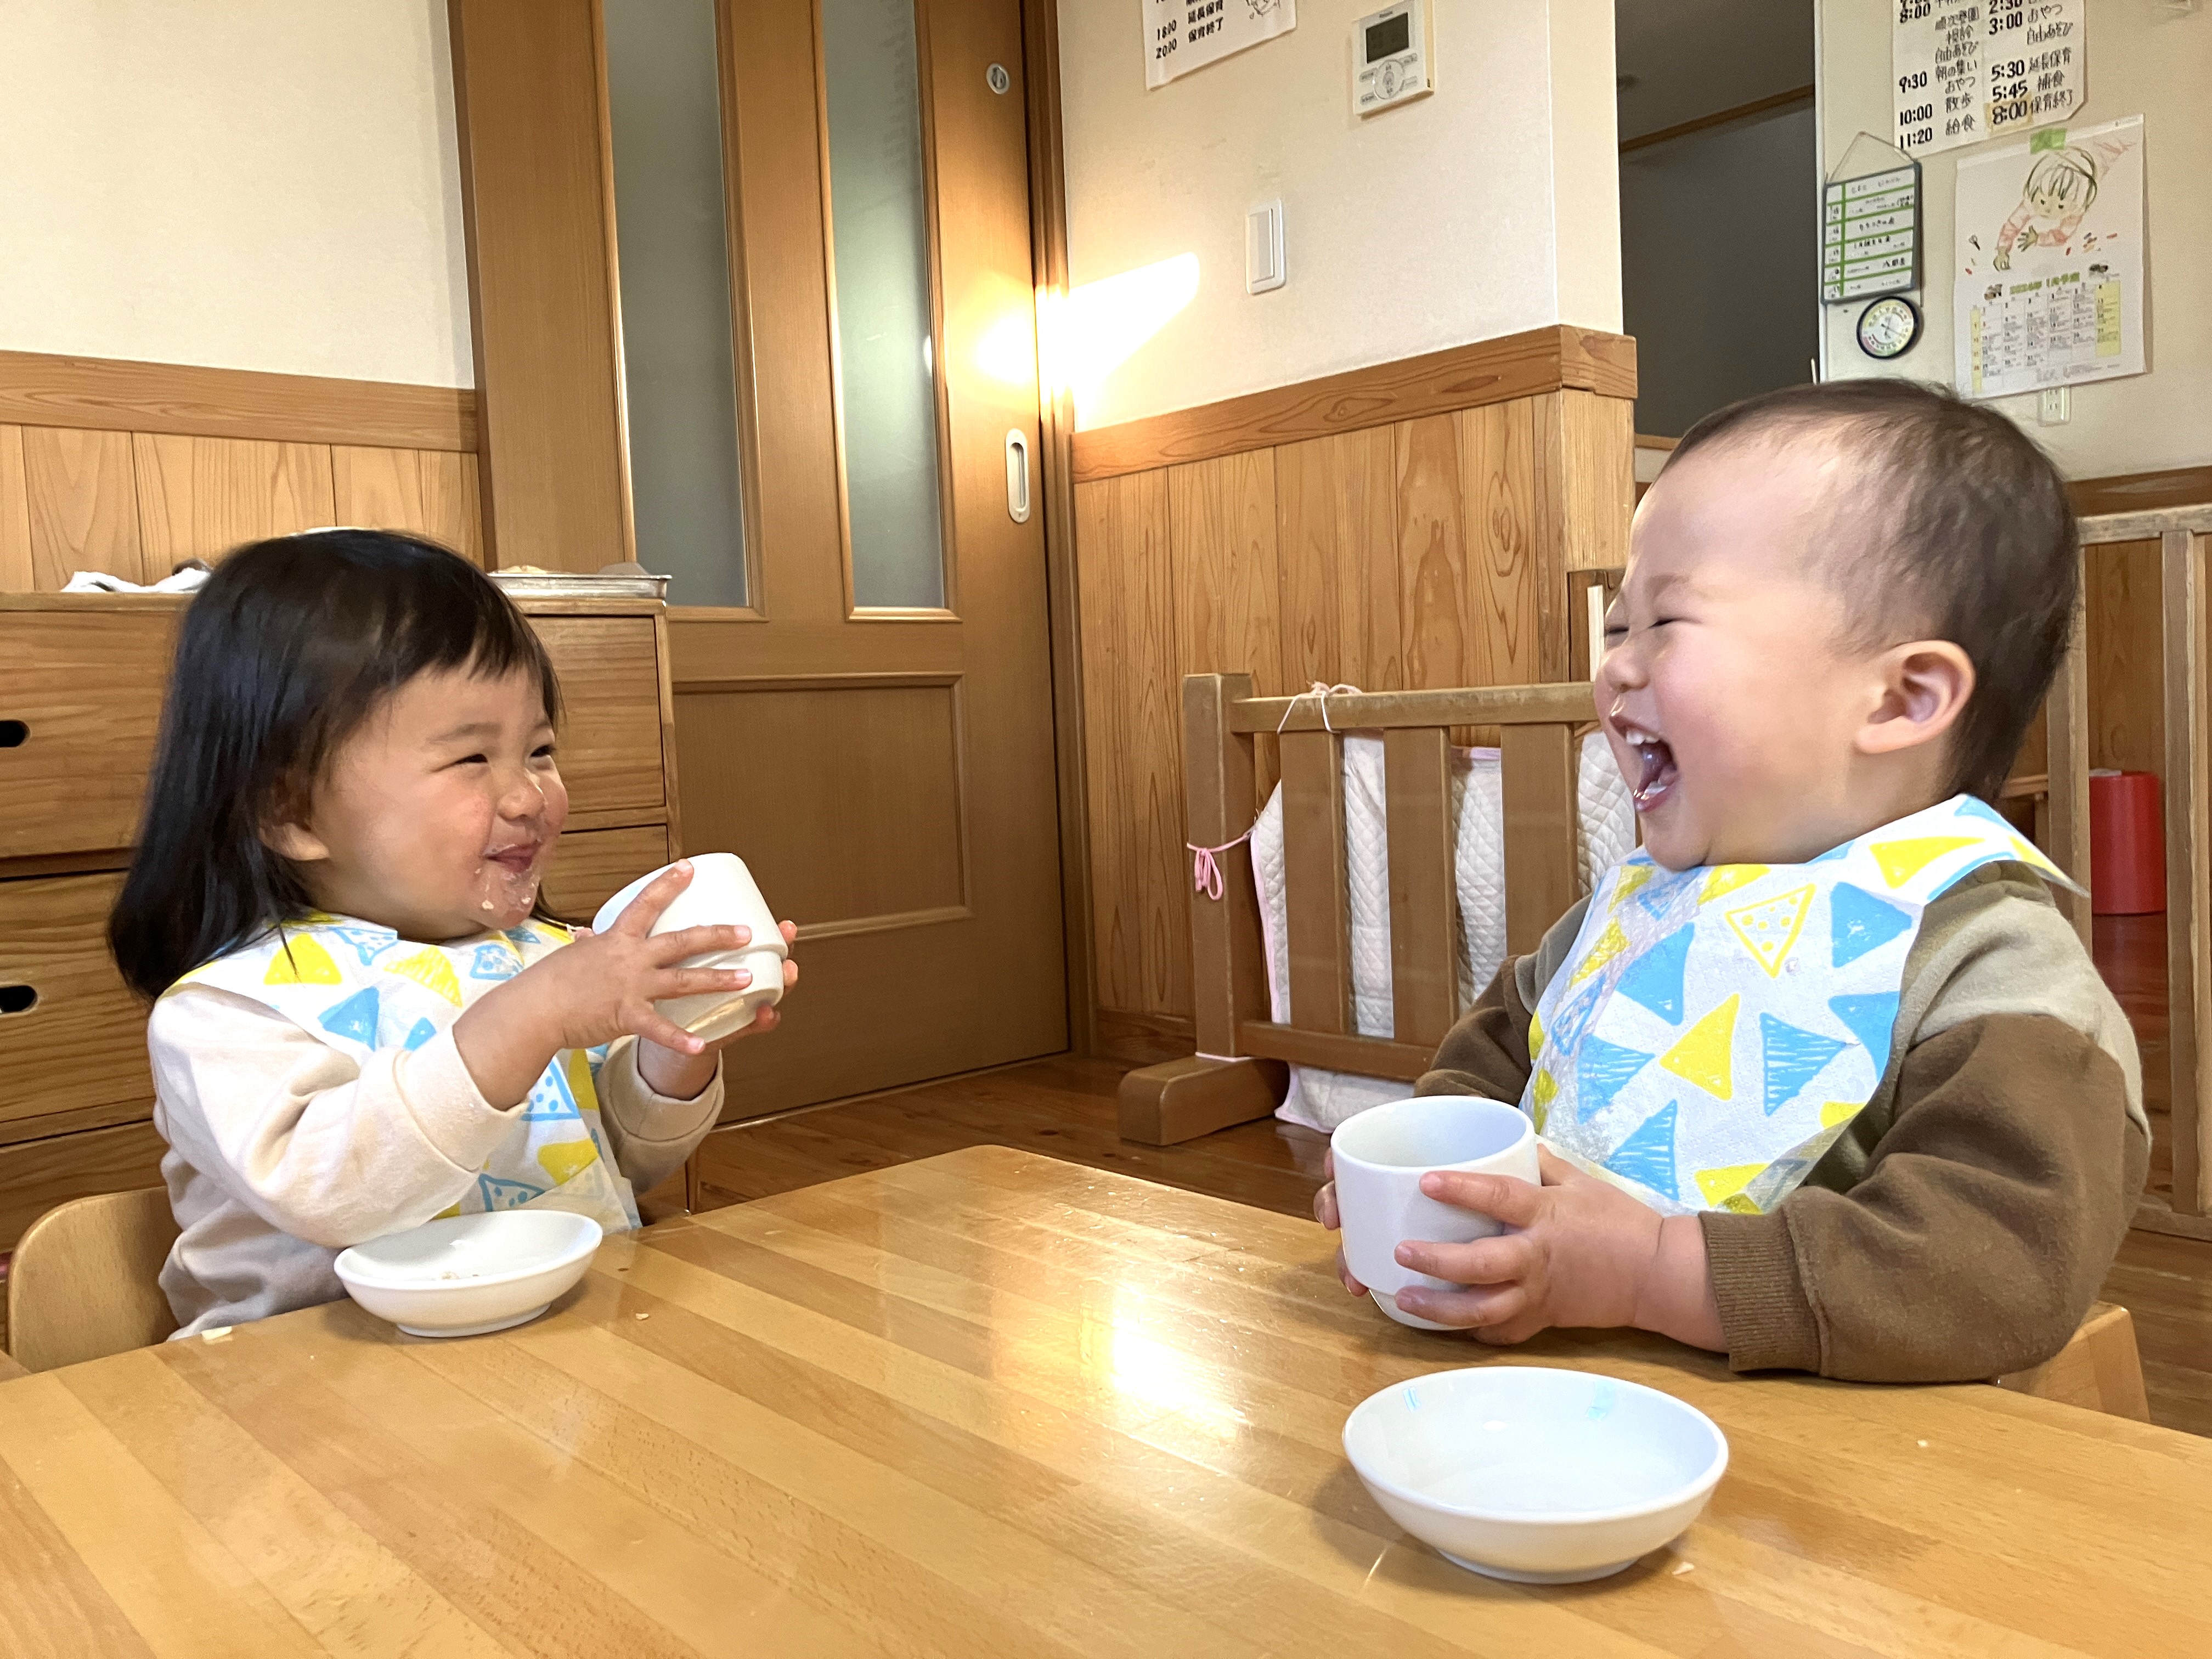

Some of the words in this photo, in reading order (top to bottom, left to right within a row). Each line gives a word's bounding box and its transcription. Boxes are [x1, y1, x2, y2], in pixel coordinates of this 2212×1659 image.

[1989, 10, 2022, 35] 3:00
[2028, 4, 2063, 22] おやつ
[1991, 59, 2024, 82] 5:30
[1899, 71, 1927, 93] 9:30
[1945, 76, 1976, 94] おやつ
[1993, 80, 2028, 103] 5:45
[1900, 104, 1932, 126] 10:00
[1993, 100, 2027, 125] 8:00
[1900, 127, 1932, 149] 11:20
